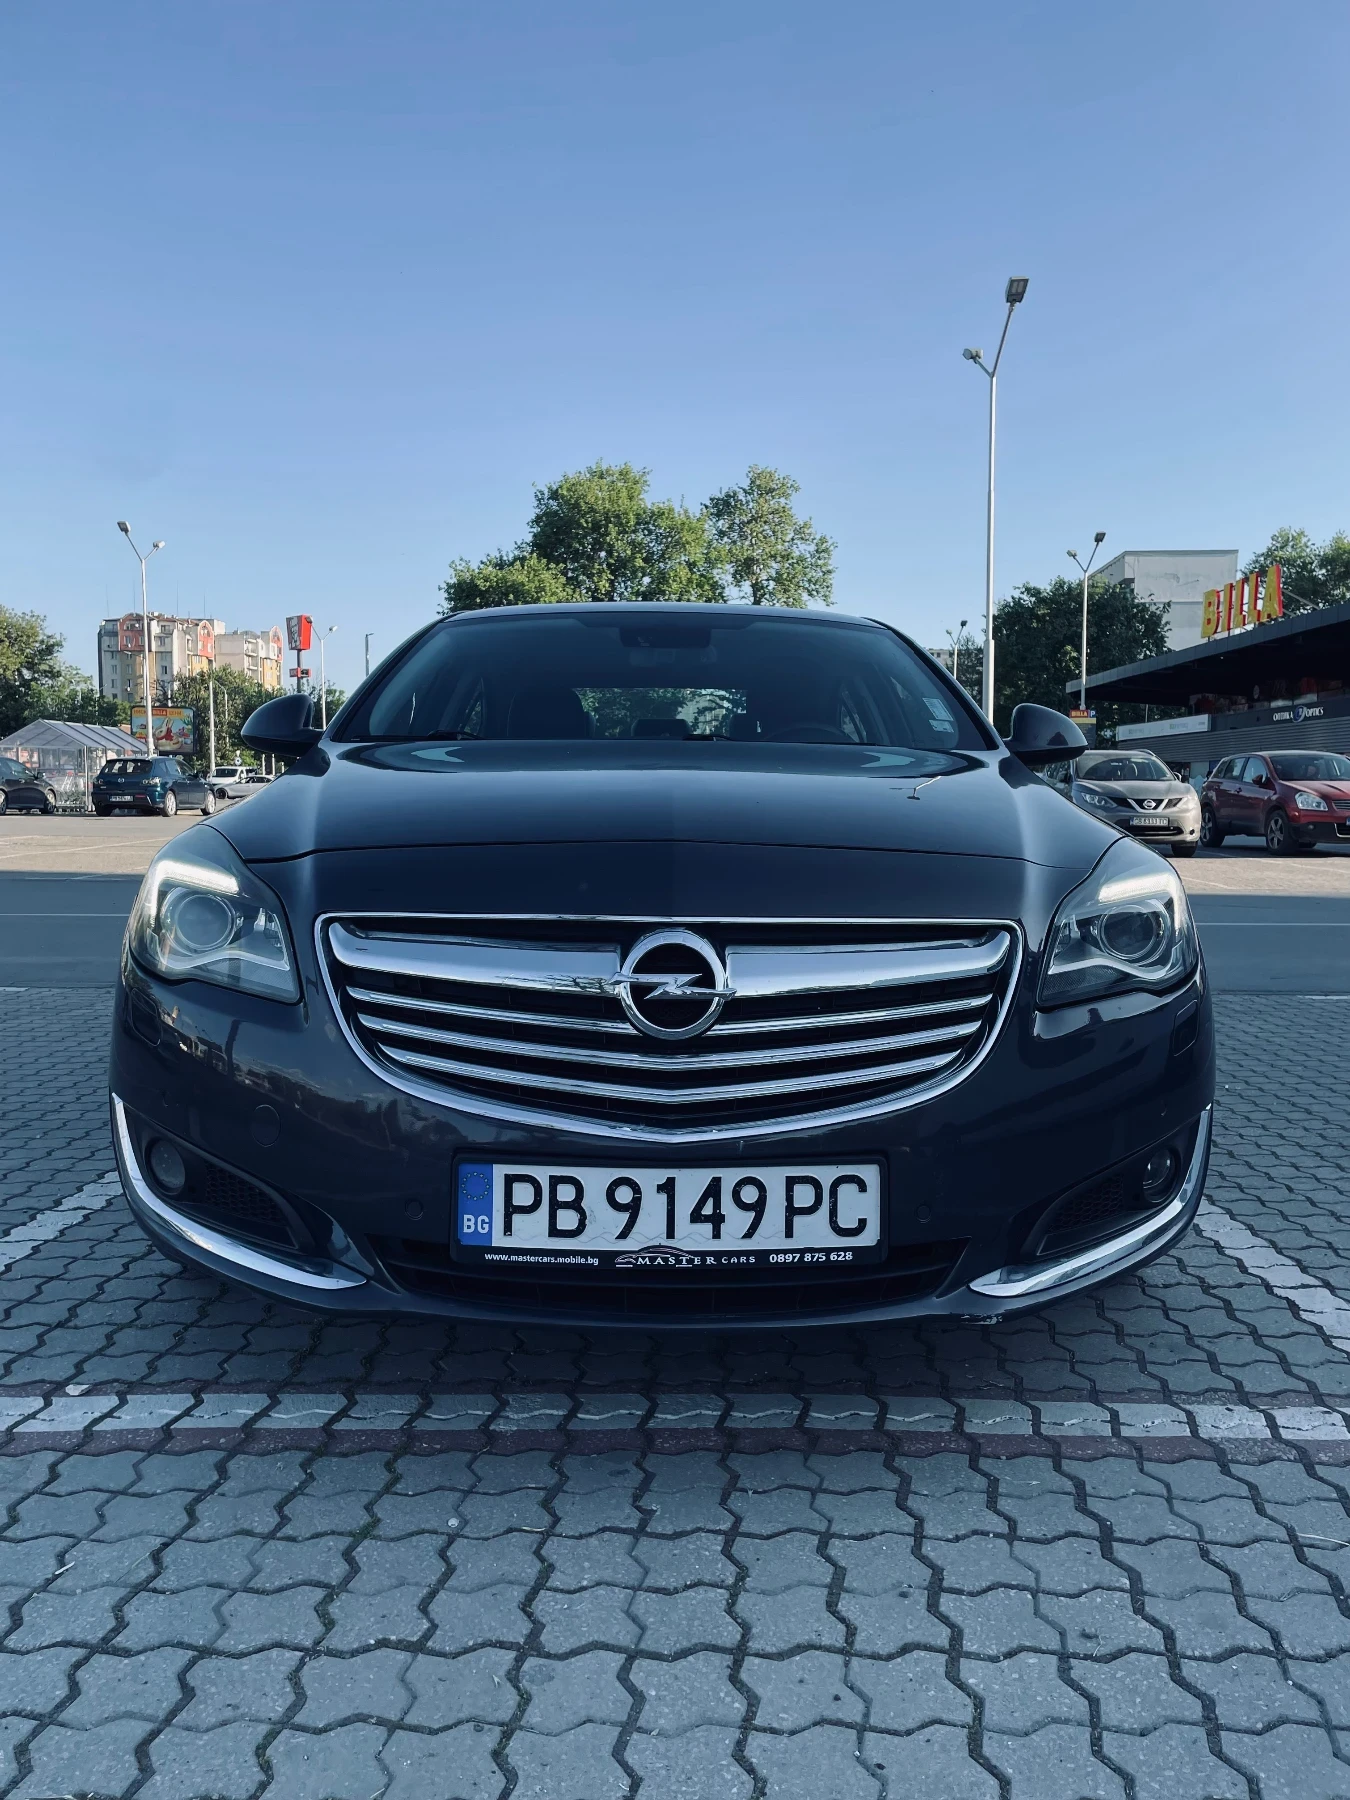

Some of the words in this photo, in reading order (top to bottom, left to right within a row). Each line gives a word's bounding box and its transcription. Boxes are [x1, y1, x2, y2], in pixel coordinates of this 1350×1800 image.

[1201, 564, 1283, 639] BILLA
[1090, 710, 1096, 718] P
[504, 1173, 587, 1238] PB
[606, 1176, 767, 1239] 9149
[785, 1174, 868, 1238] PC
[463, 1214, 489, 1234] BG
[484, 1253, 599, 1266] www.mastercars.mobile.bg
[636, 1255, 717, 1265] MASTER
[721, 1255, 756, 1264] CARS
[769, 1253, 801, 1263] 0897
[803, 1252, 826, 1262] 875
[829, 1251, 853, 1261] 628
